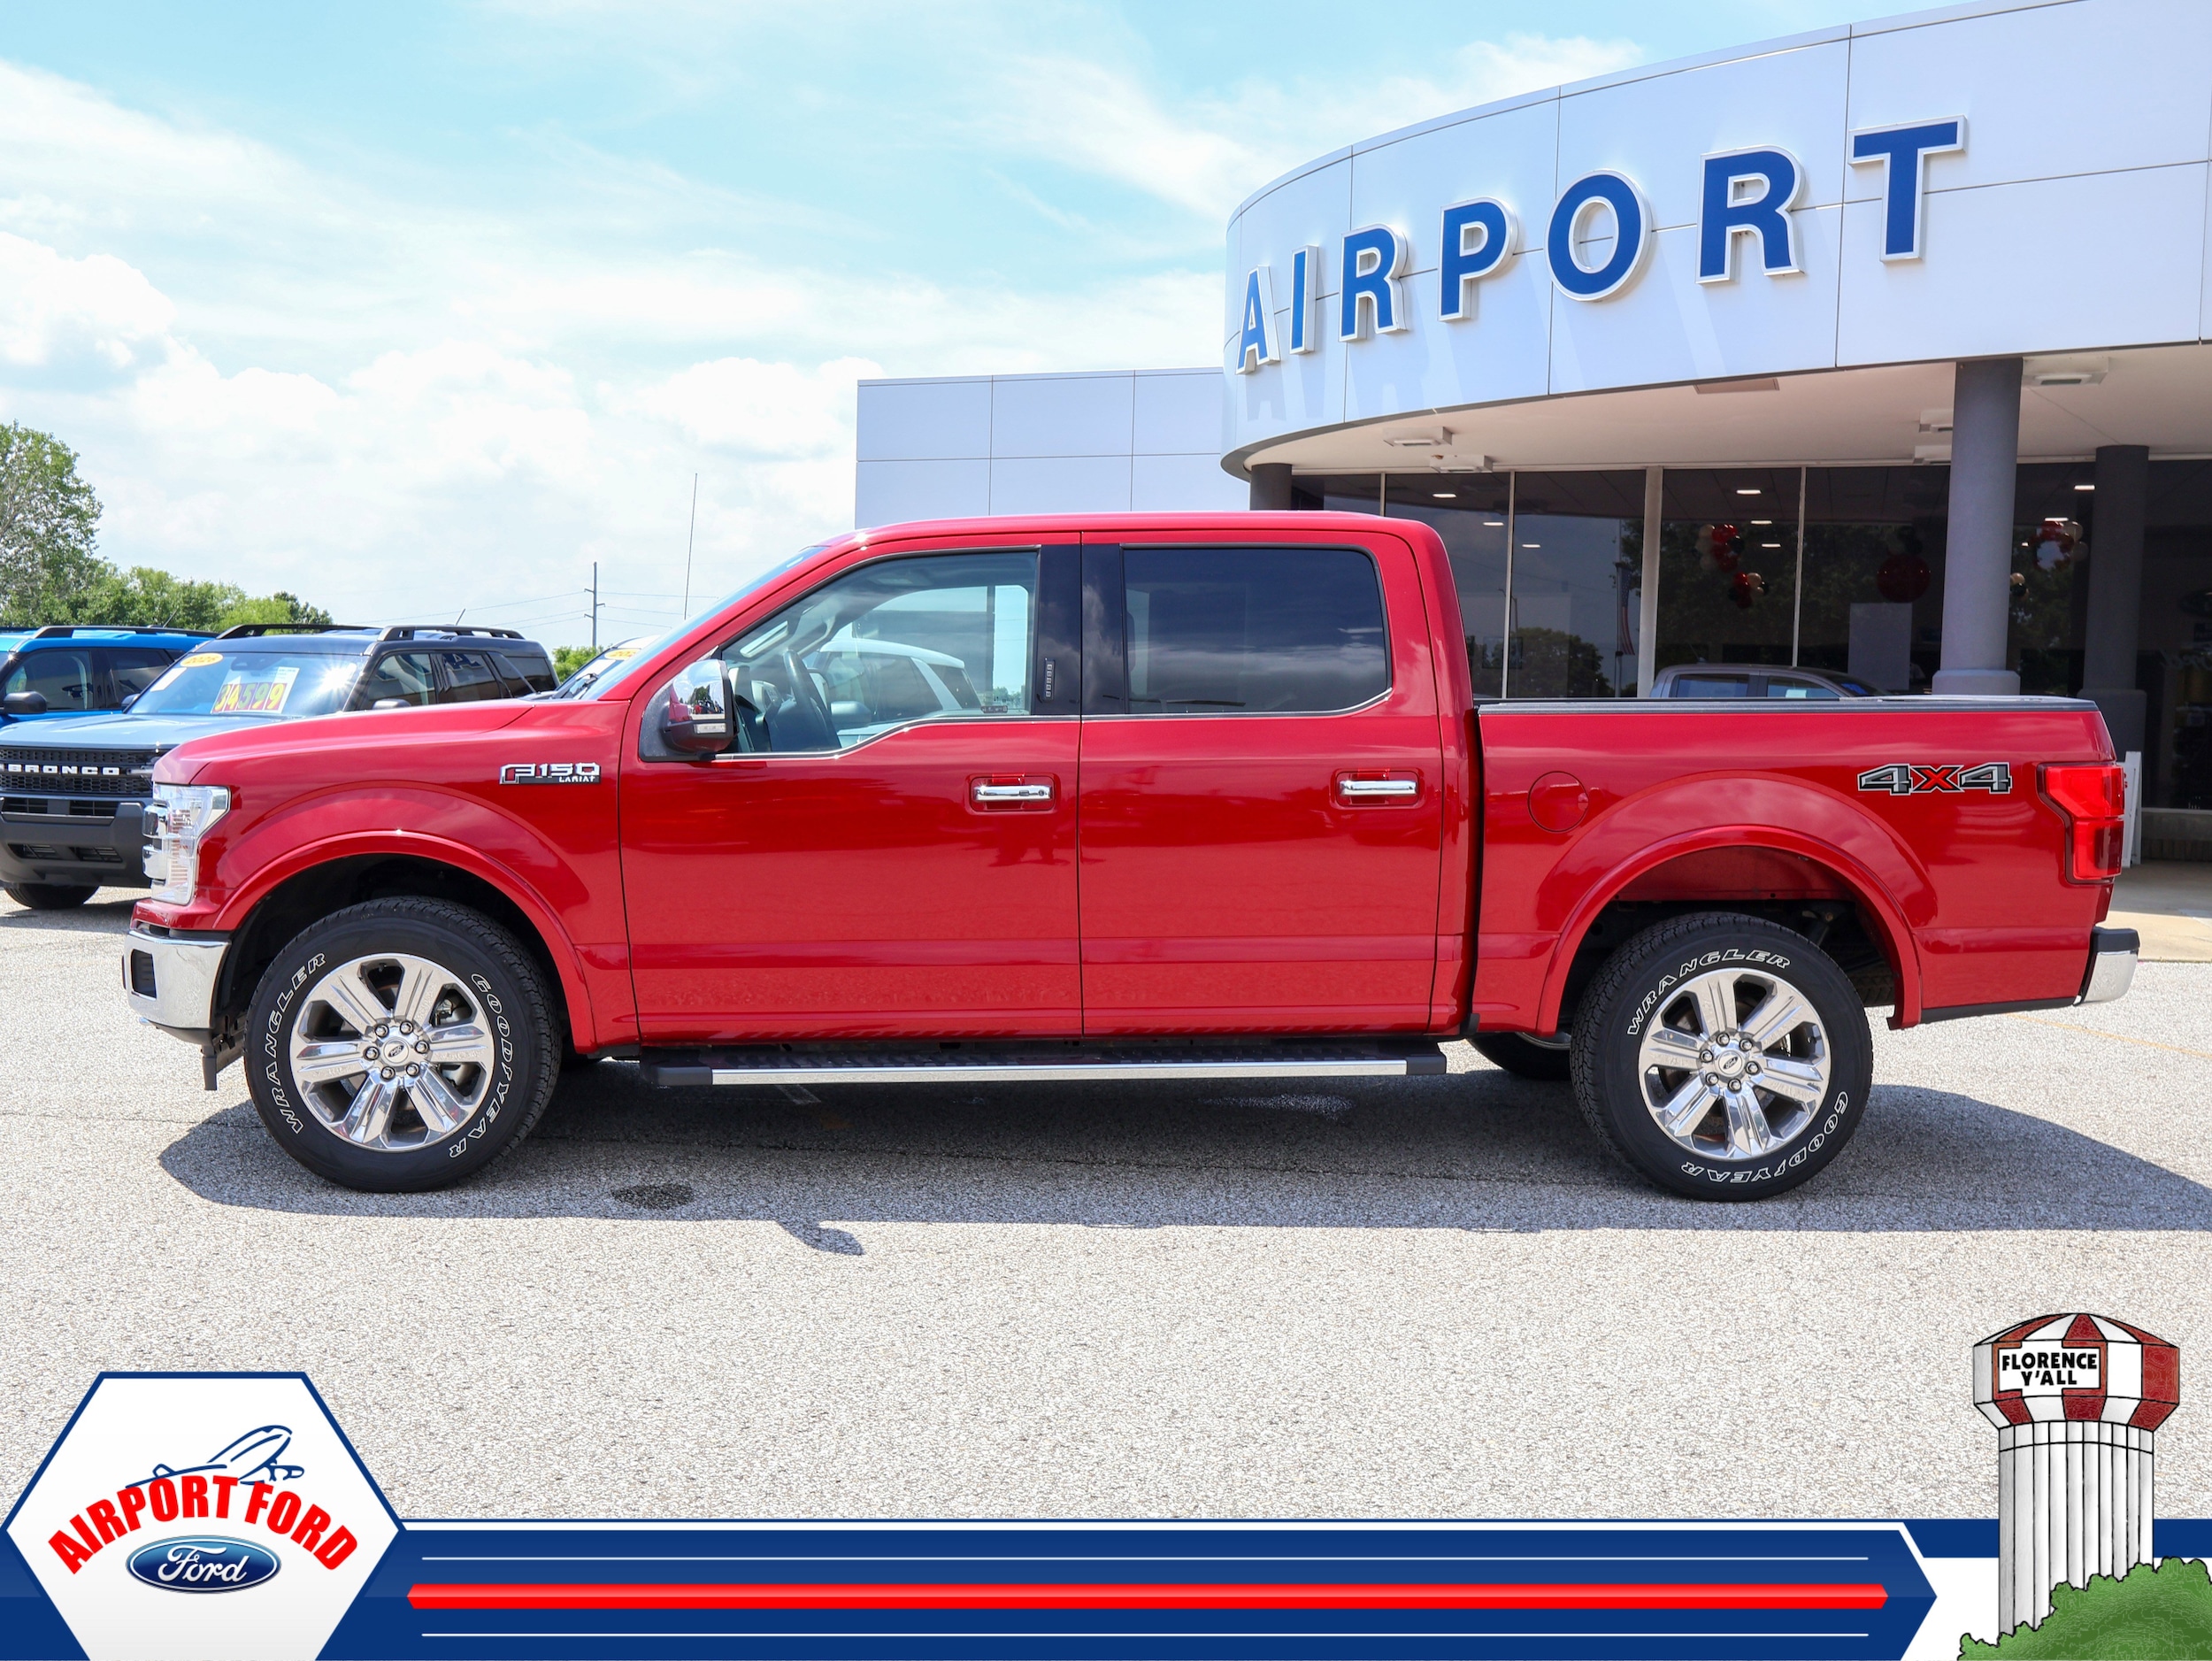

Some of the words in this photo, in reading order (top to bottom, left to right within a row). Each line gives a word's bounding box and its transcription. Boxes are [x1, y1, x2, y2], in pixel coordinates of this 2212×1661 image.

[1236, 115, 1966, 374] AIRPORT
[214, 682, 286, 711] 34599
[8, 764, 119, 775] BRONCO
[1627, 949, 1790, 1035] WRANGLER
[265, 953, 326, 1134] WRANGLER
[449, 973, 513, 1157] GOODYEAR
[1681, 1091, 1848, 1183] GOODYEAR
